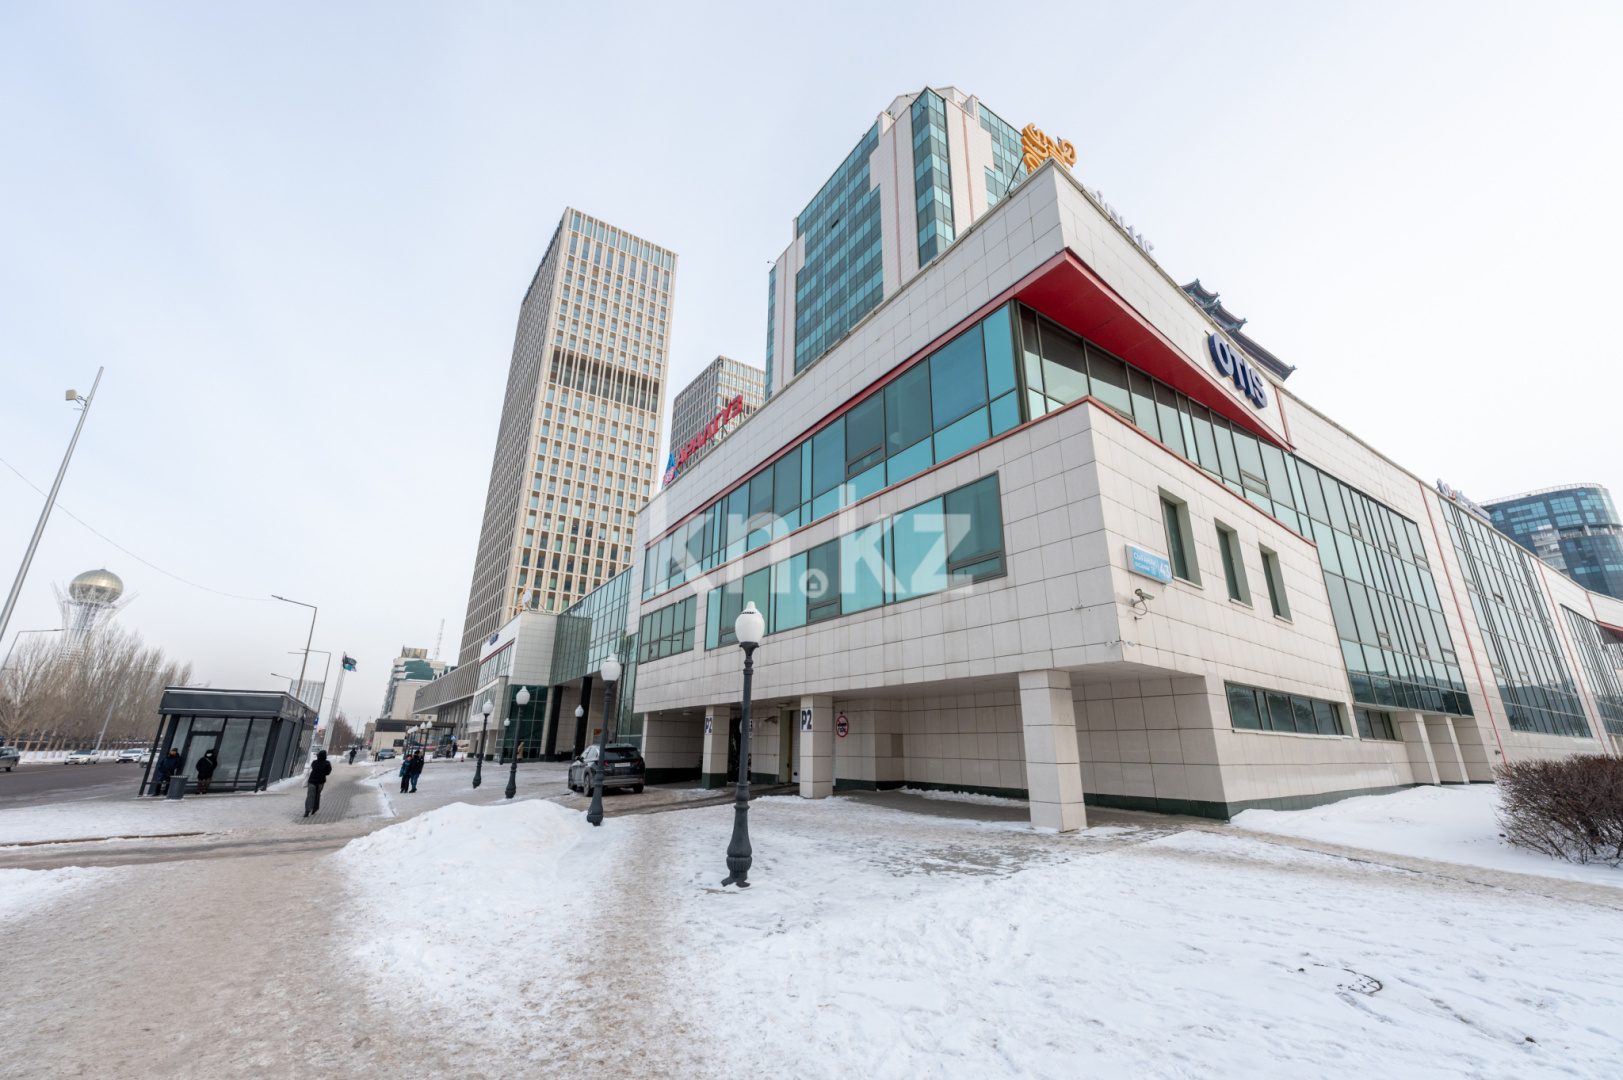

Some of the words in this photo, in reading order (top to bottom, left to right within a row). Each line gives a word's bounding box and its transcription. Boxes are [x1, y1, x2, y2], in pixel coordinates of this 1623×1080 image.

[1208, 332, 1268, 409] OTIS
[1160, 563, 1170, 578] 43
[801, 709, 812, 730] P2
